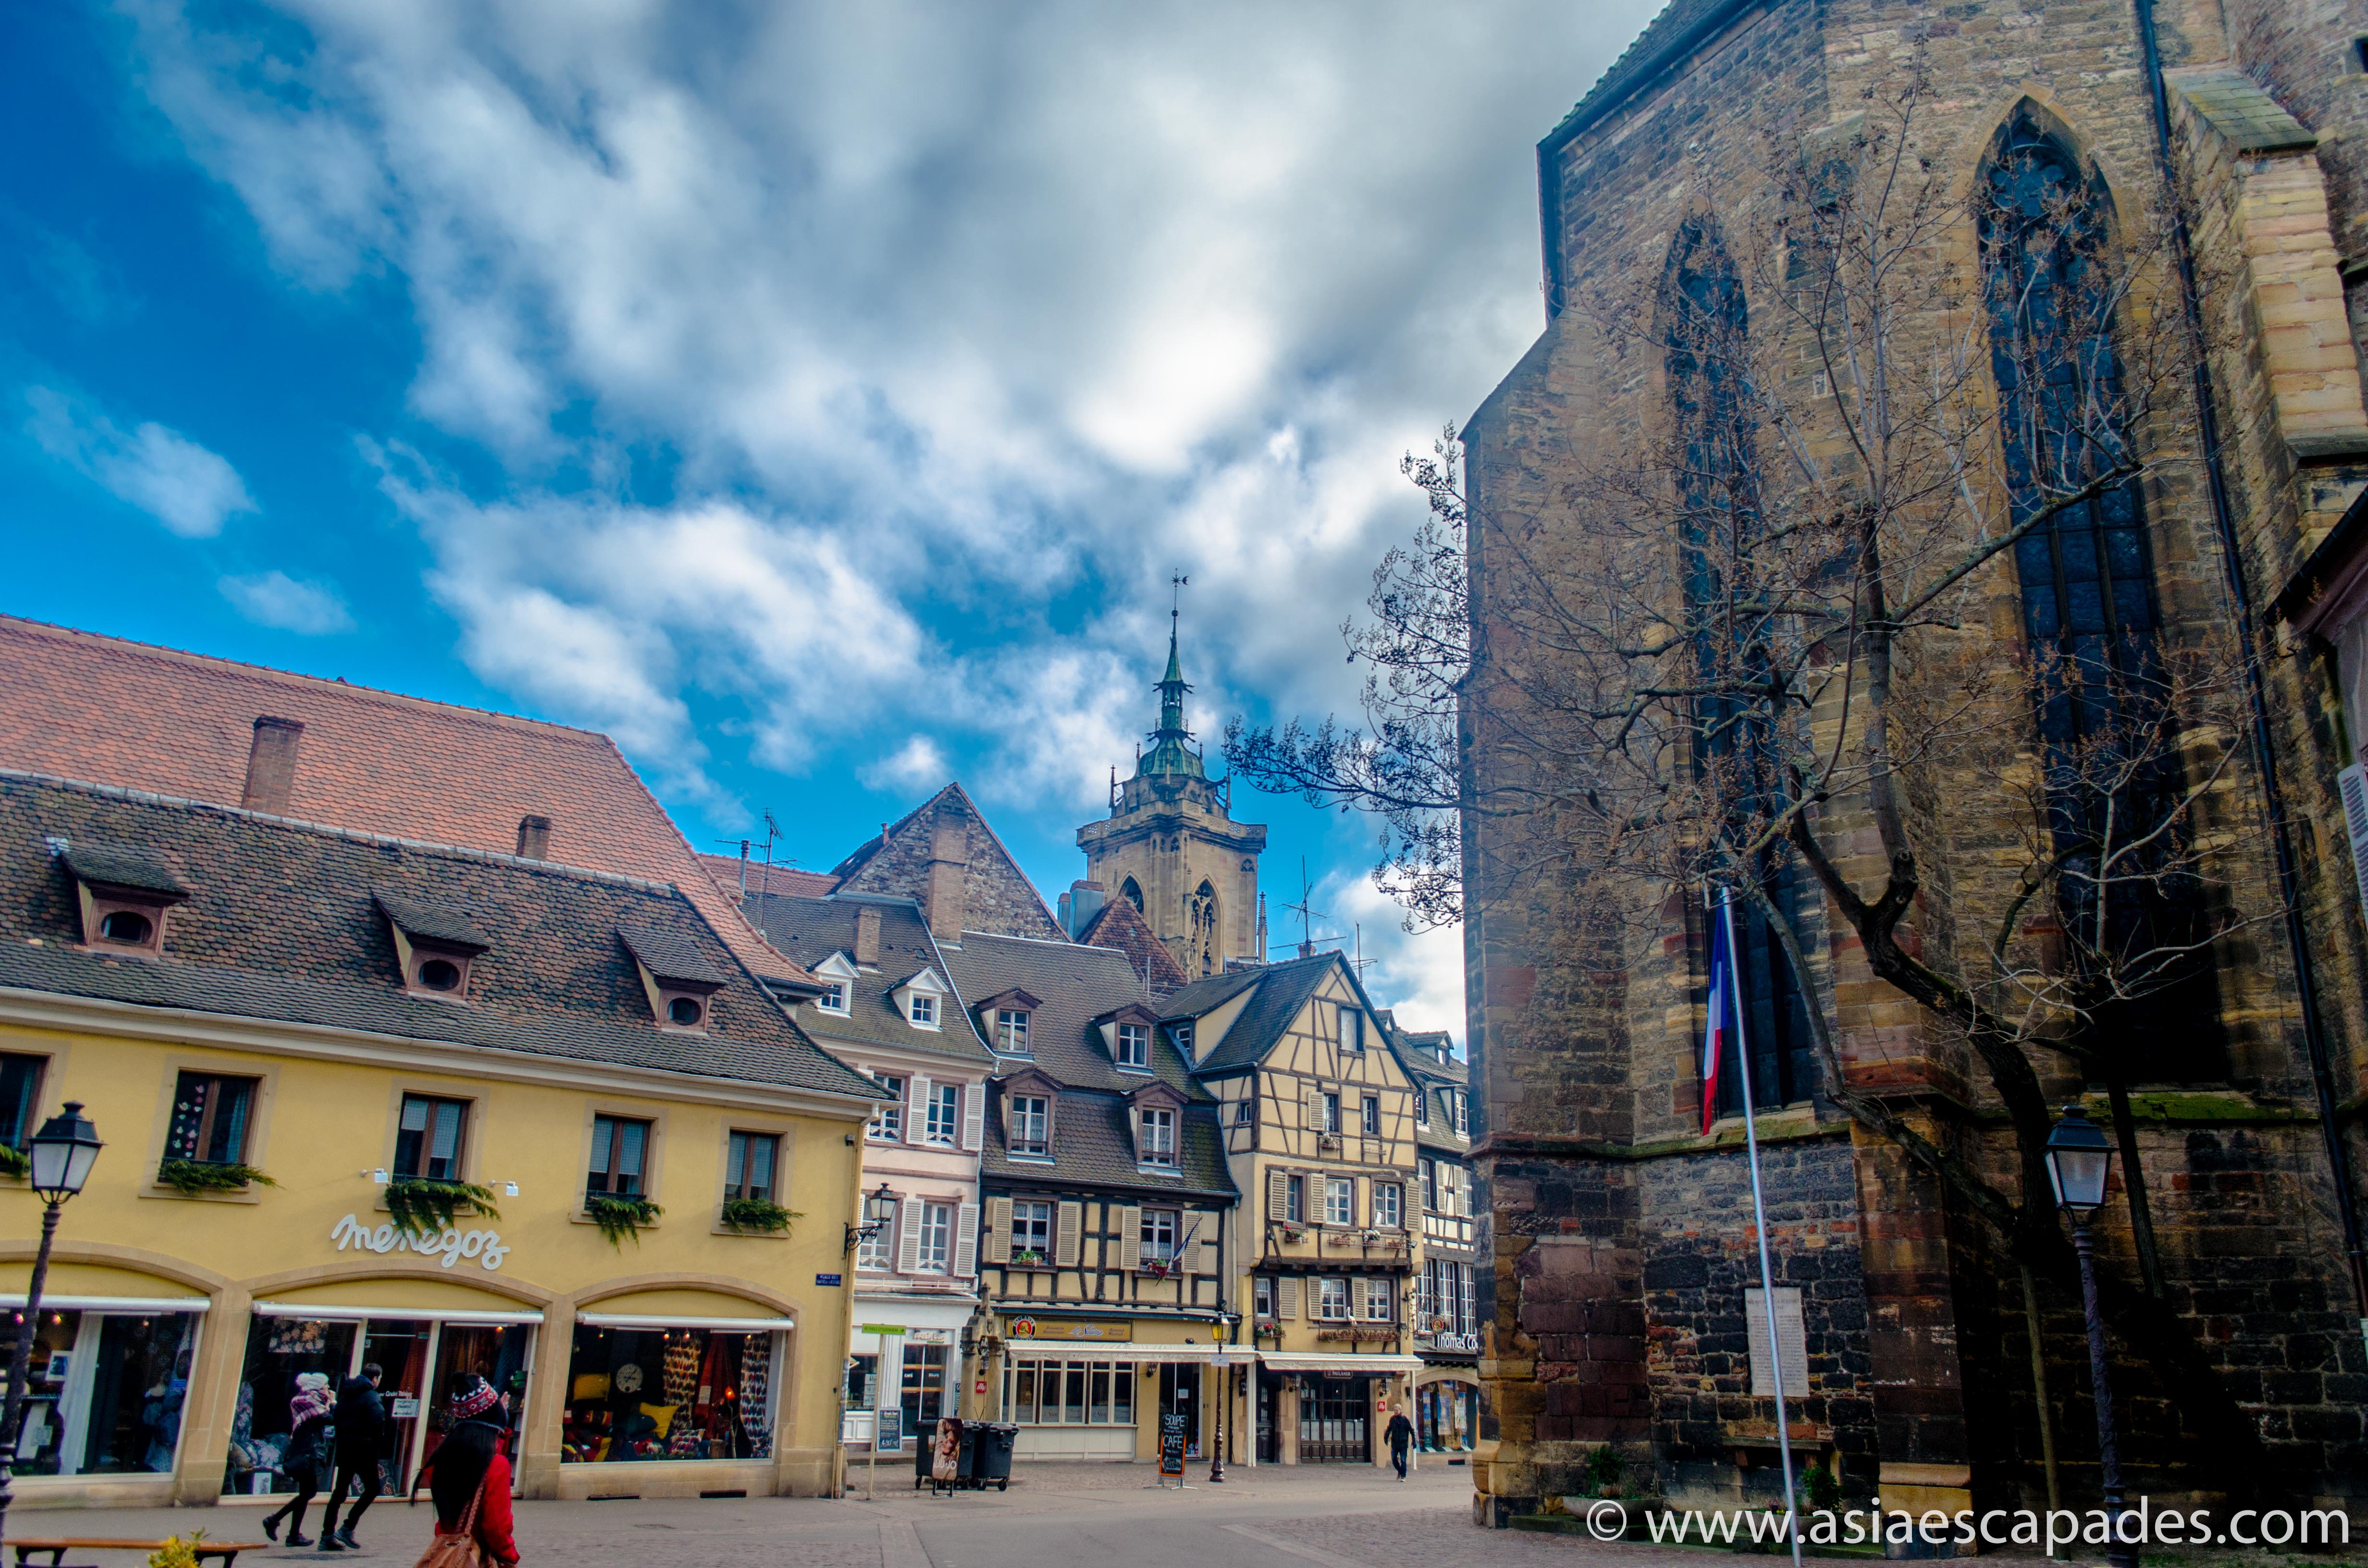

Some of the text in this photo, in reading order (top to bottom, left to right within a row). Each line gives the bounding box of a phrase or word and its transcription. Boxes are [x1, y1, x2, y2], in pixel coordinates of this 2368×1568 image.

[1437, 1334, 1465, 1349] Thomas
[976, 1383, 986, 1392] illy
[1165, 1414, 1185, 1427] SOUPE
